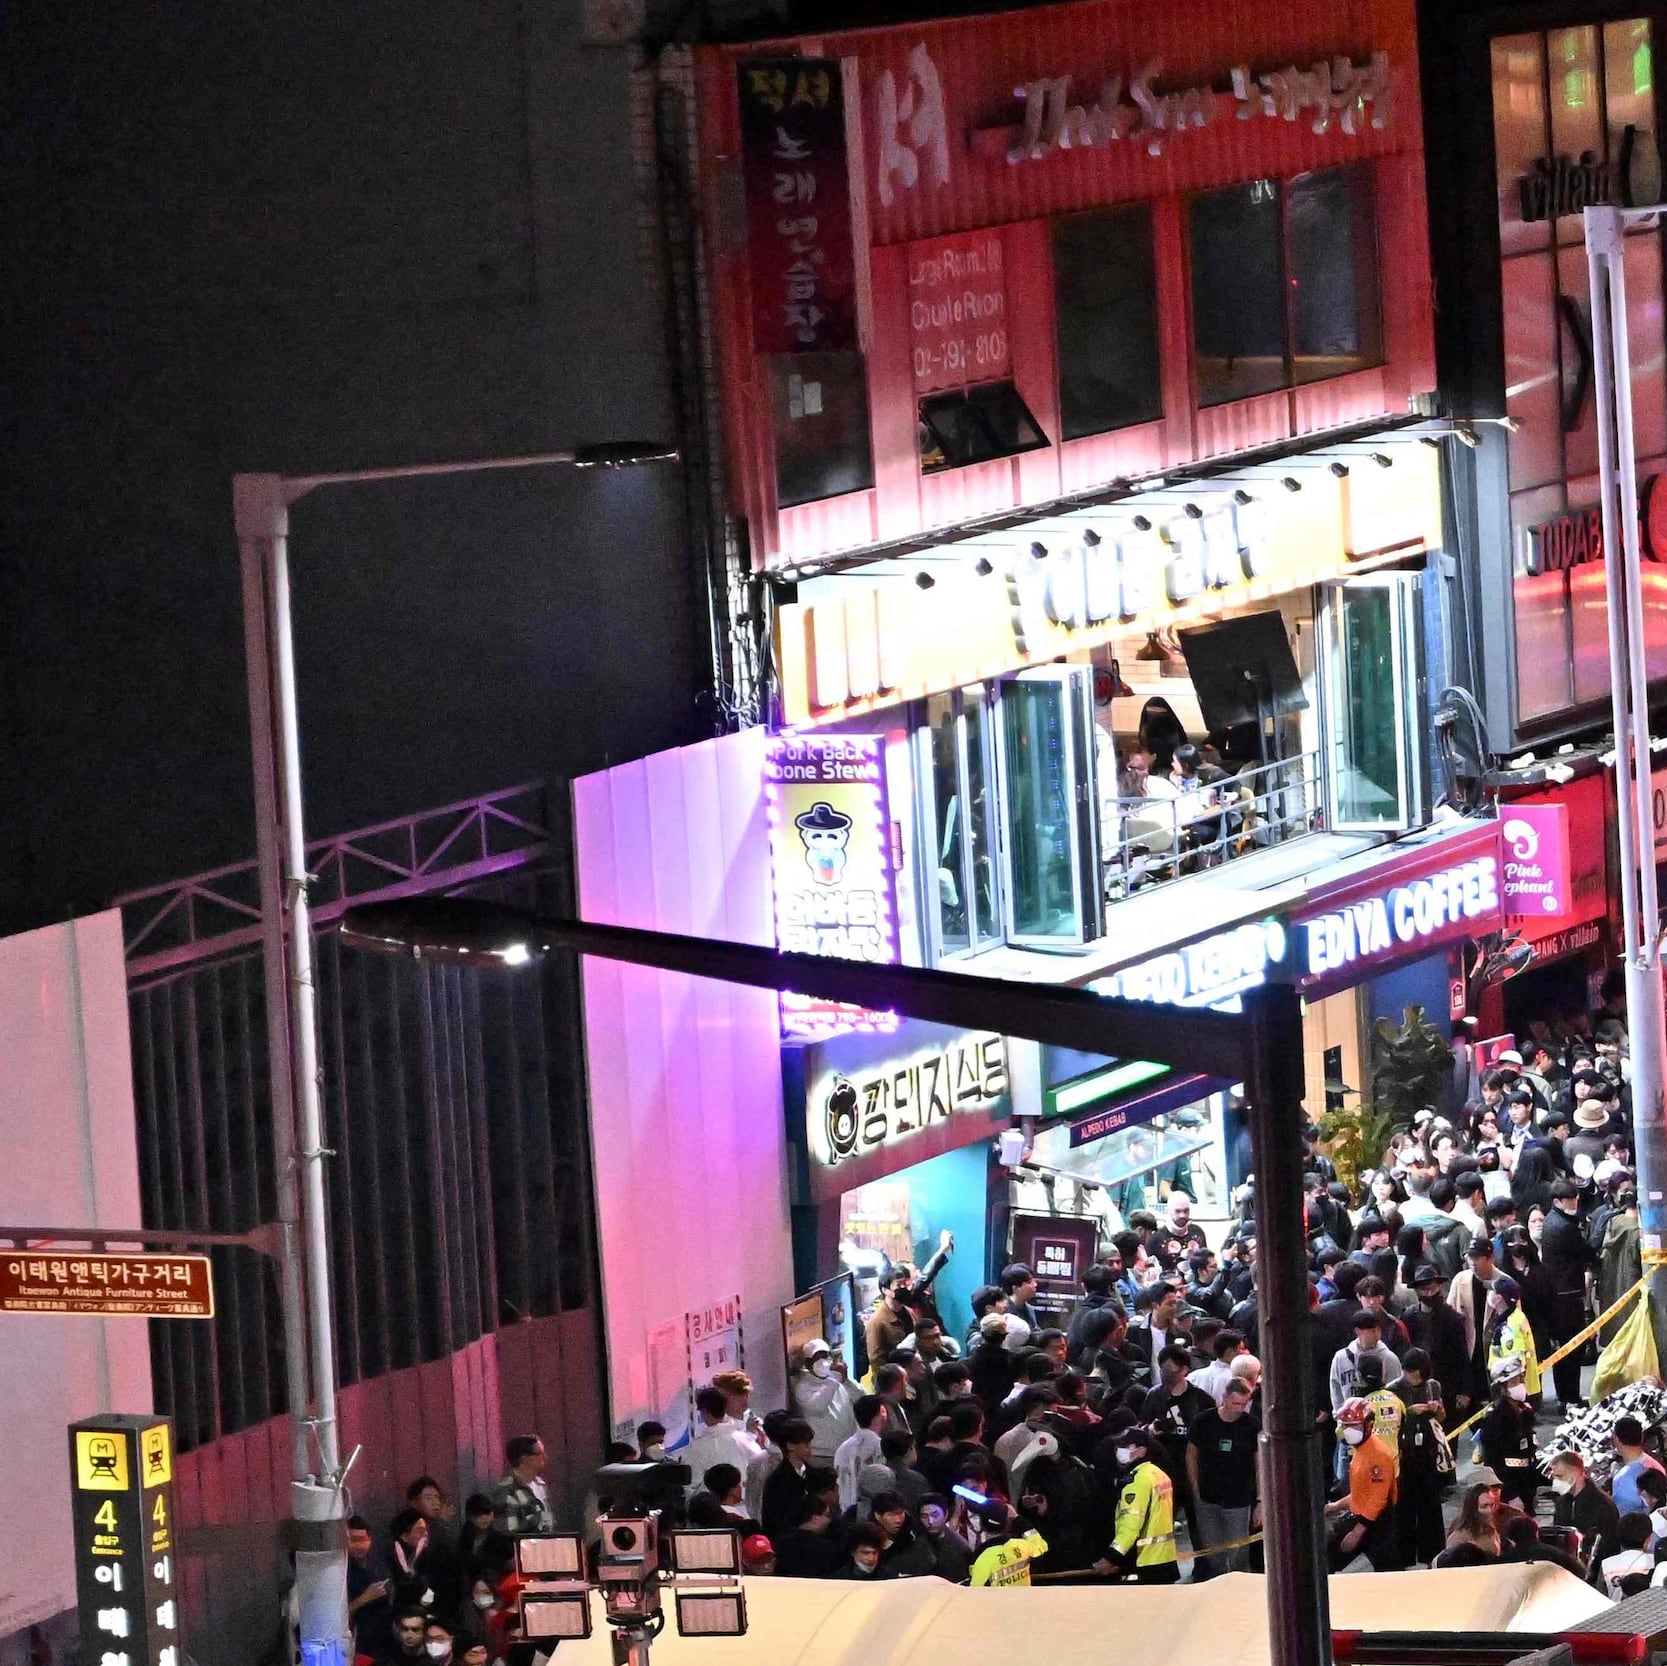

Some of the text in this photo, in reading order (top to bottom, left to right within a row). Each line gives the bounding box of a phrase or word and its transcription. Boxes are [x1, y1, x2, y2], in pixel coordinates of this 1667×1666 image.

[822, 761, 868, 780] Stew
[1503, 862, 1543, 880] Pink
[1503, 877, 1554, 896] ephant
[1309, 856, 1498, 974] EDIYA COFFEE
[1080, 1112, 1127, 1139] ALPEDO KEBAB
[9, 1260, 192, 1286] 이태원앤틱가구거리
[19, 1285, 188, 1299] Itaewon Antique Furniture Street
[95, 1500, 118, 1532] 4
[153, 1494, 167, 1527] 4
